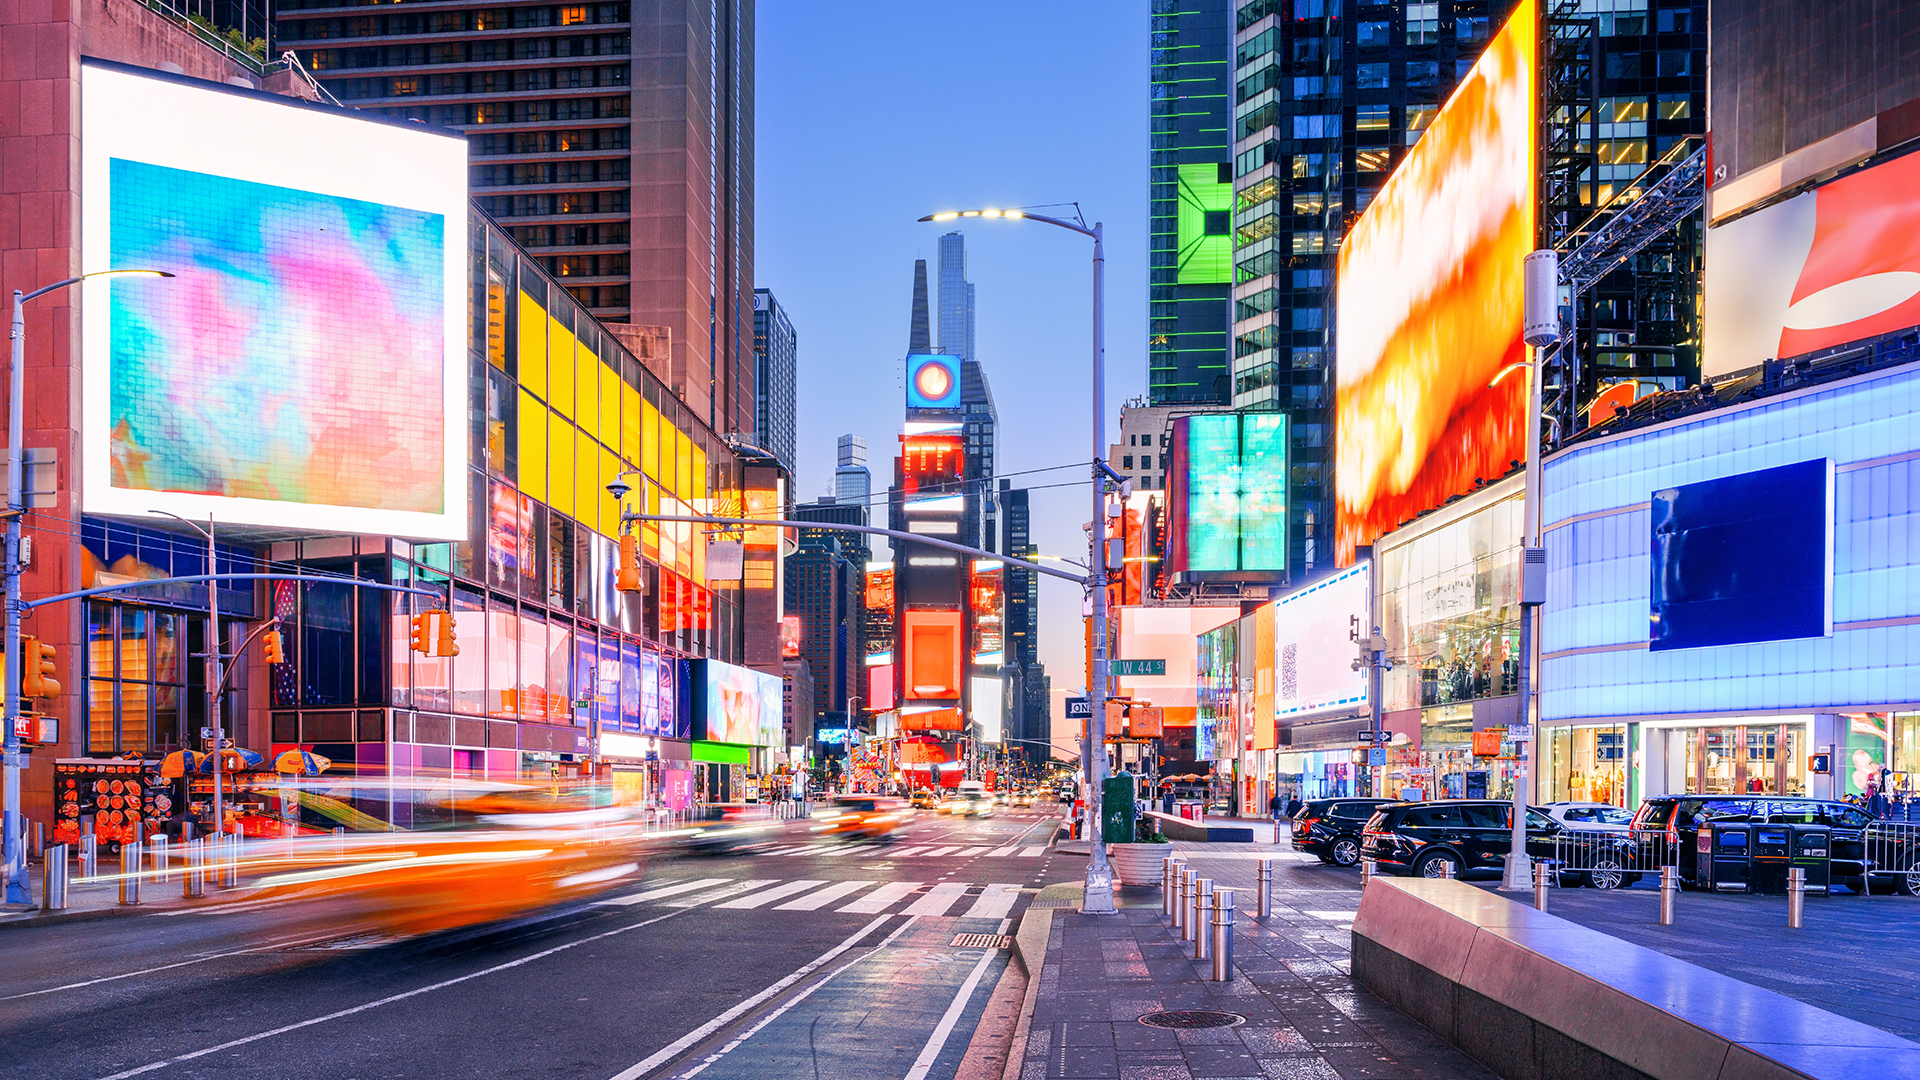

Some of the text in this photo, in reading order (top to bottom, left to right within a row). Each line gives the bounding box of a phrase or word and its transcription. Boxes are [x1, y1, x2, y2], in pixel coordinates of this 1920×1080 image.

[1122, 661, 1164, 674] W 44 St
